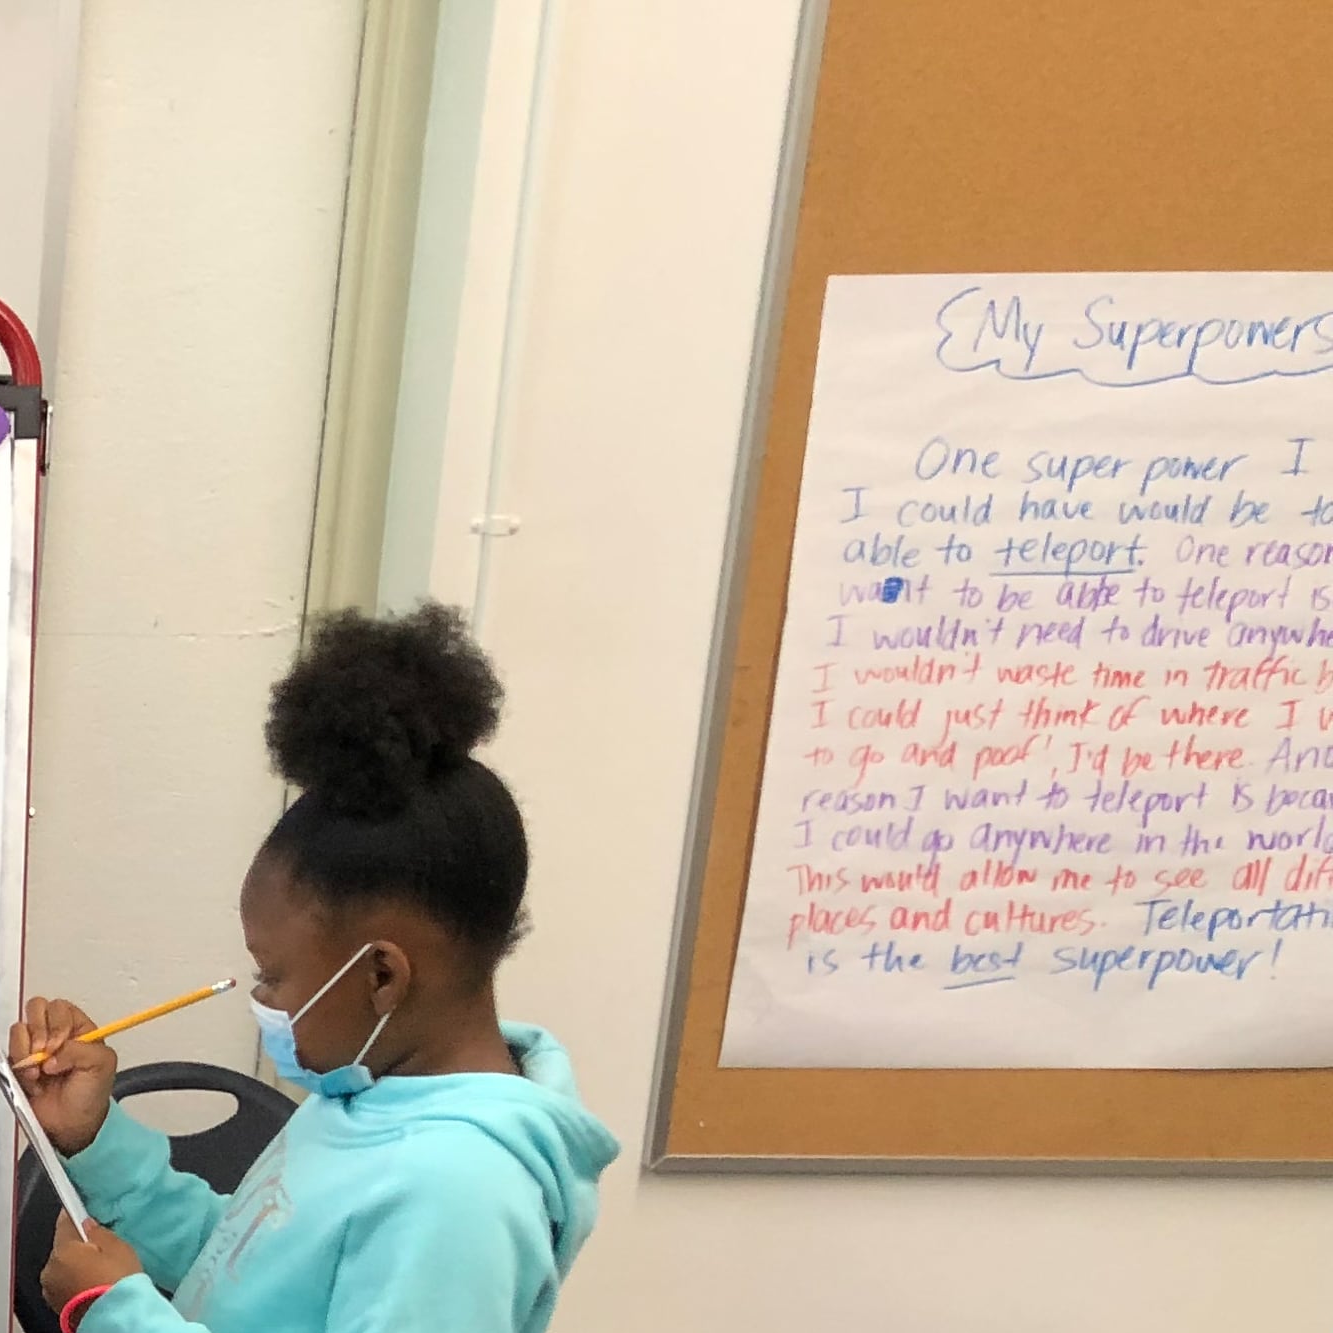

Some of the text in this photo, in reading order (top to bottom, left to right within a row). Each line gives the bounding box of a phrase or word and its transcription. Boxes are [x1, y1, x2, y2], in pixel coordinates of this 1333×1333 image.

[973, 295, 1045, 371] My
[915, 435, 1316, 497] One super power I
[840, 486, 870, 523] I
[897, 493, 993, 527] could
[1019, 490, 1093, 521] have
[1119, 494, 1213, 525] would
[1229, 489, 1271, 529] be
[843, 532, 920, 568] able
[933, 533, 973, 564] to
[1176, 534, 1230, 569] One
[953, 577, 983, 608] to
[997, 583, 1034, 613] be
[1132, 576, 1166, 608] to
[1176, 575, 1292, 623] teleport
[1311, 584, 1331, 612] is
[826, 614, 851, 647] I
[872, 614, 1006, 651] wouldn't
[1017, 615, 1086, 650] need
[1101, 614, 1131, 644] to
[1141, 614, 1211, 648] drive
[811, 662, 840, 693] I
[853, 651, 982, 686] wouldn't
[997, 661, 1077, 689] waste
[1092, 661, 1146, 690] time
[1164, 668, 1189, 688] in
[1203, 656, 1308, 693] traffic
[809, 700, 835, 729] I
[848, 698, 922, 731] could
[942, 698, 1005, 749] just
[1019, 695, 1100, 731] think
[1109, 695, 1151, 732] of
[1161, 701, 1250, 730] where
[1276, 700, 1302, 731] I
[803, 745, 834, 768] to
[848, 744, 885, 788] go
[901, 741, 957, 770] and
[1121, 746, 1153, 778] be
[802, 787, 897, 814] reason
[904, 784, 926, 811] I
[944, 778, 1028, 810] want
[1036, 781, 1069, 810] to
[1084, 779, 1208, 828] teleport
[1233, 782, 1254, 813] is
[793, 820, 813, 848] I
[832, 815, 914, 853] could
[921, 828, 955, 868] go
[970, 822, 1112, 866] anywhere
[1135, 834, 1166, 854] in
[787, 863, 850, 896] This
[860, 863, 941, 898] would
[959, 859, 1038, 891] allow
[1052, 867, 1093, 892] me
[1105, 865, 1137, 895] to
[1154, 867, 1206, 897] see
[1232, 856, 1274, 897] all
[787, 901, 878, 951] places
[889, 898, 953, 933] and
[807, 937, 1284, 992] is the best superpower!
